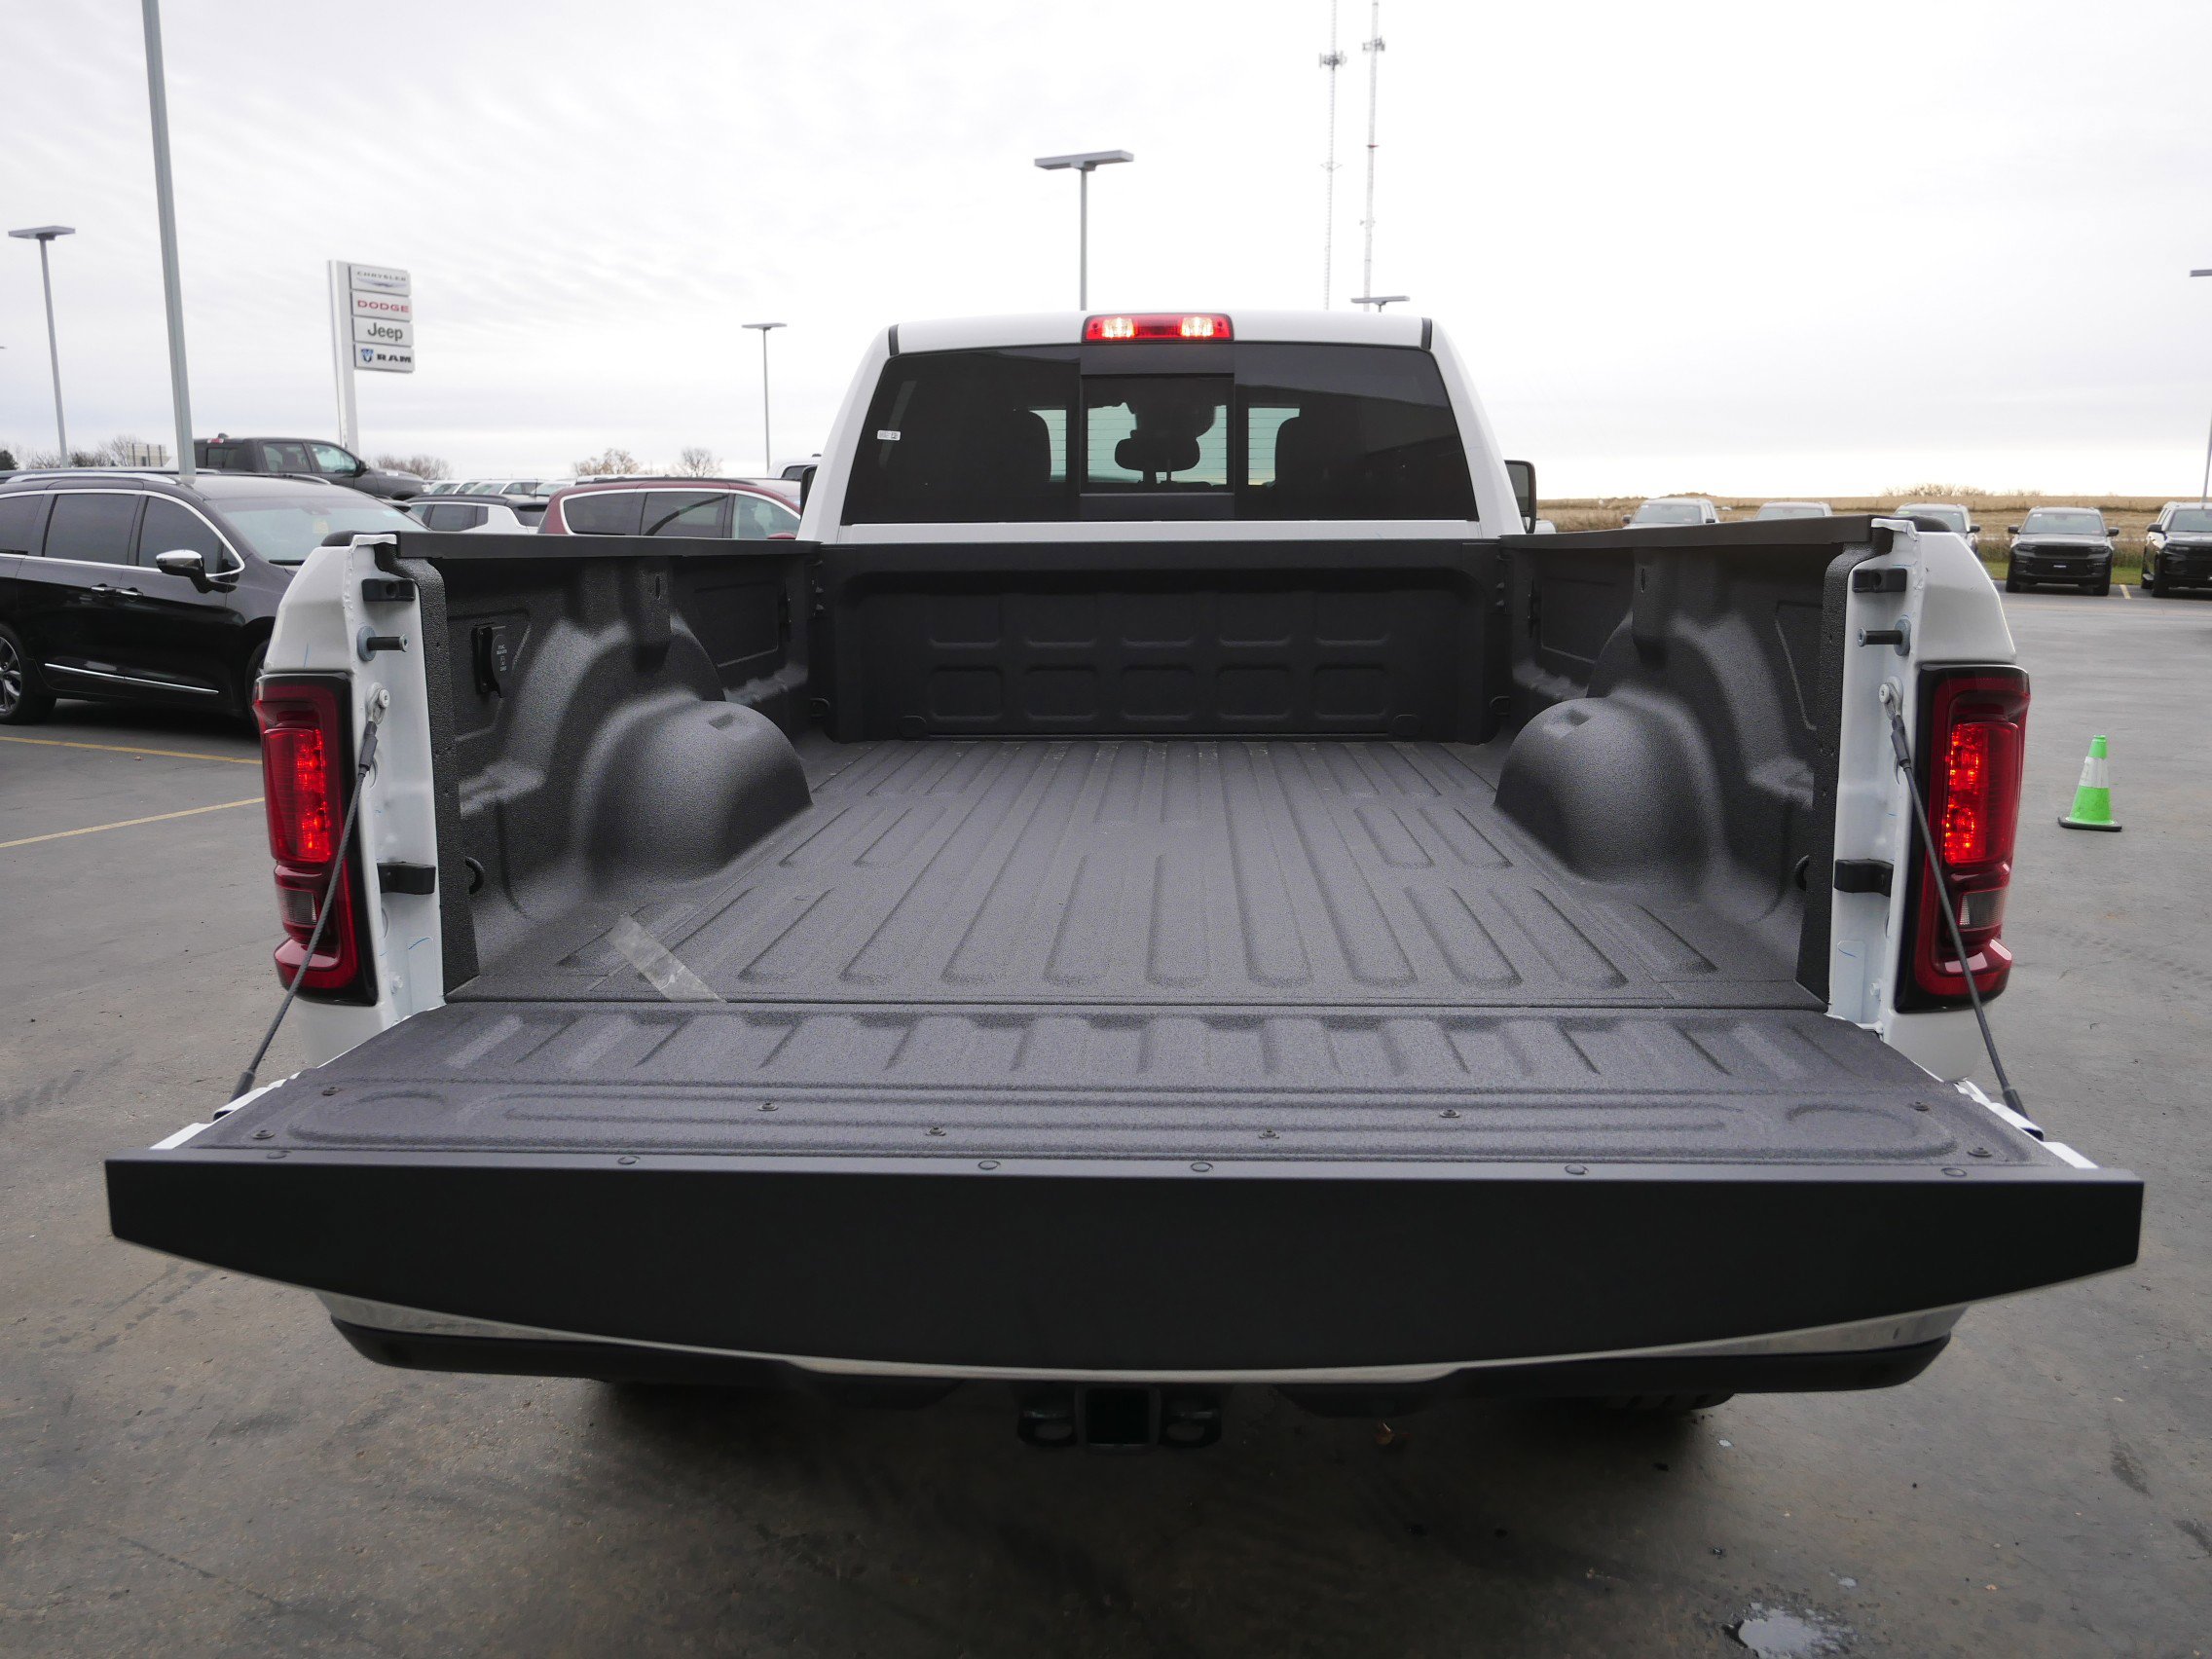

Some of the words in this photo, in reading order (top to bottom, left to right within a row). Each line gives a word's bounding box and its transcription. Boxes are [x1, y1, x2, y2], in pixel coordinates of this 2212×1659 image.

[357, 300, 409, 313] DODGE
[367, 322, 403, 341] Jeep
[377, 353, 412, 363] RAM
